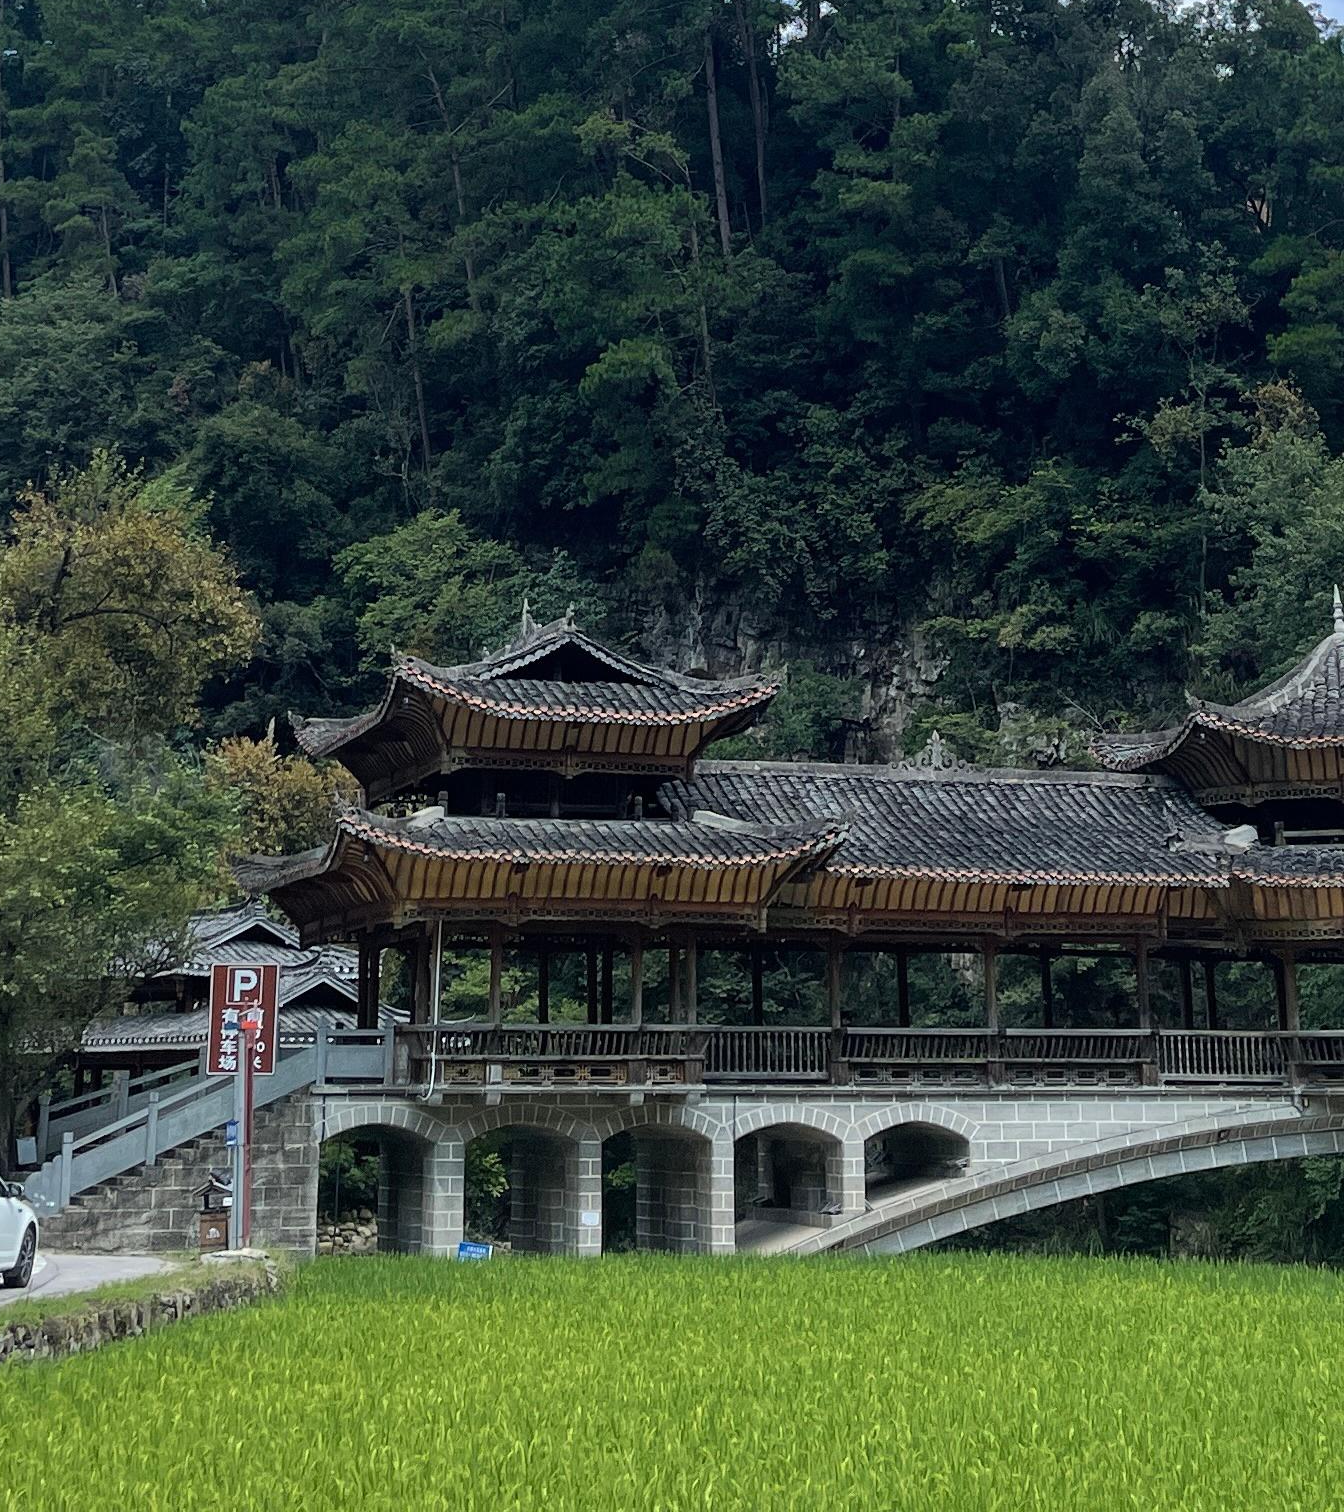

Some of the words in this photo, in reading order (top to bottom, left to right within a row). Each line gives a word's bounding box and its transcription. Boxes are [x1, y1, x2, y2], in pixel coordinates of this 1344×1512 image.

[233, 969, 258, 1002] P
[218, 1008, 240, 1071] 有停车场
